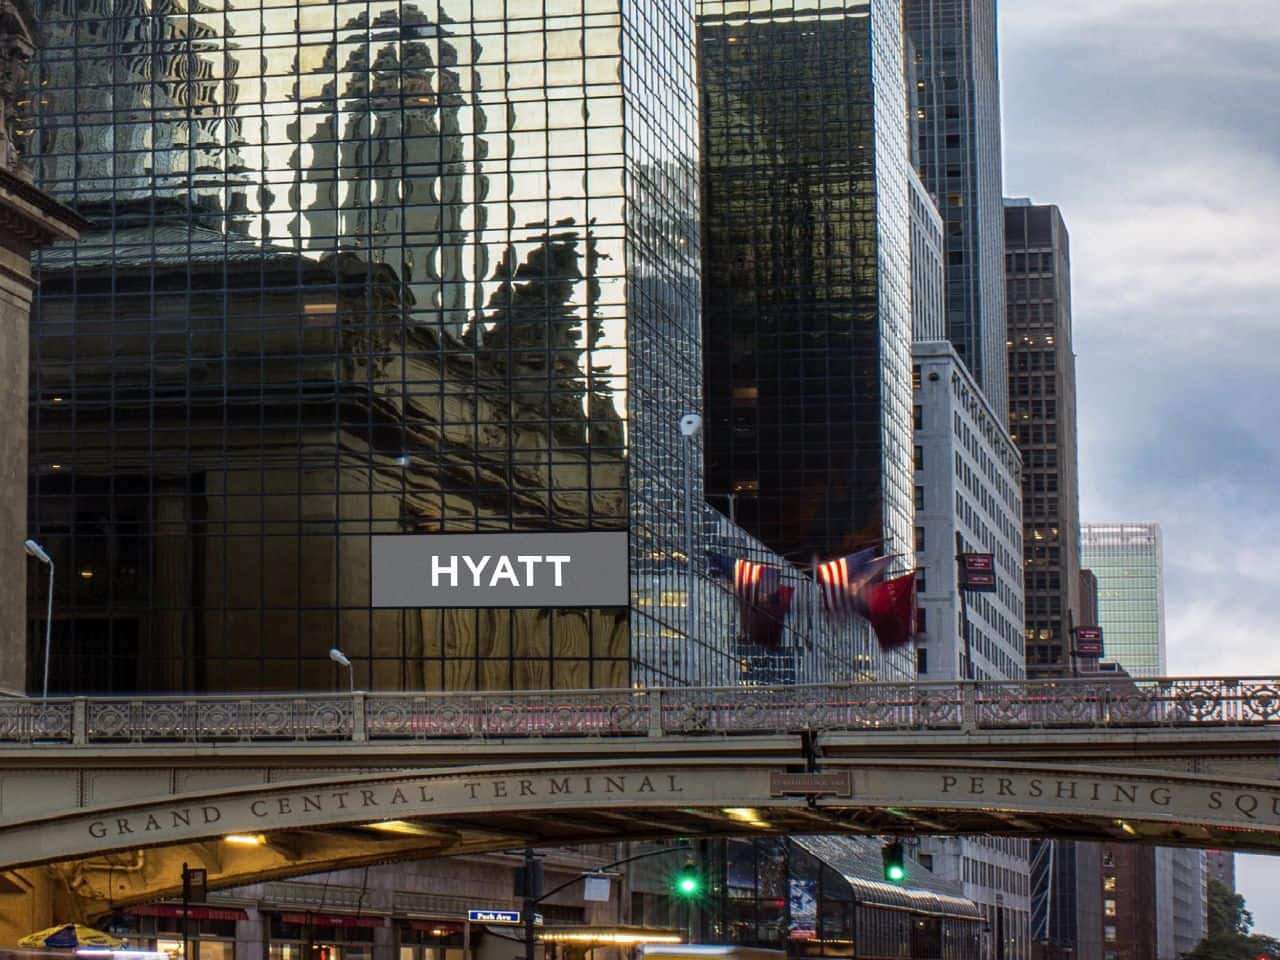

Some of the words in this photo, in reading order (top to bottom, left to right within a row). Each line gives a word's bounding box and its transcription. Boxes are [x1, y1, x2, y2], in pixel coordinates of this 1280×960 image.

[431, 555, 571, 587] HYATT
[88, 806, 221, 839] GRAND
[250, 785, 434, 817] CENTRAL
[464, 775, 683, 800] TERMINAL
[941, 775, 1171, 807] PERSHING
